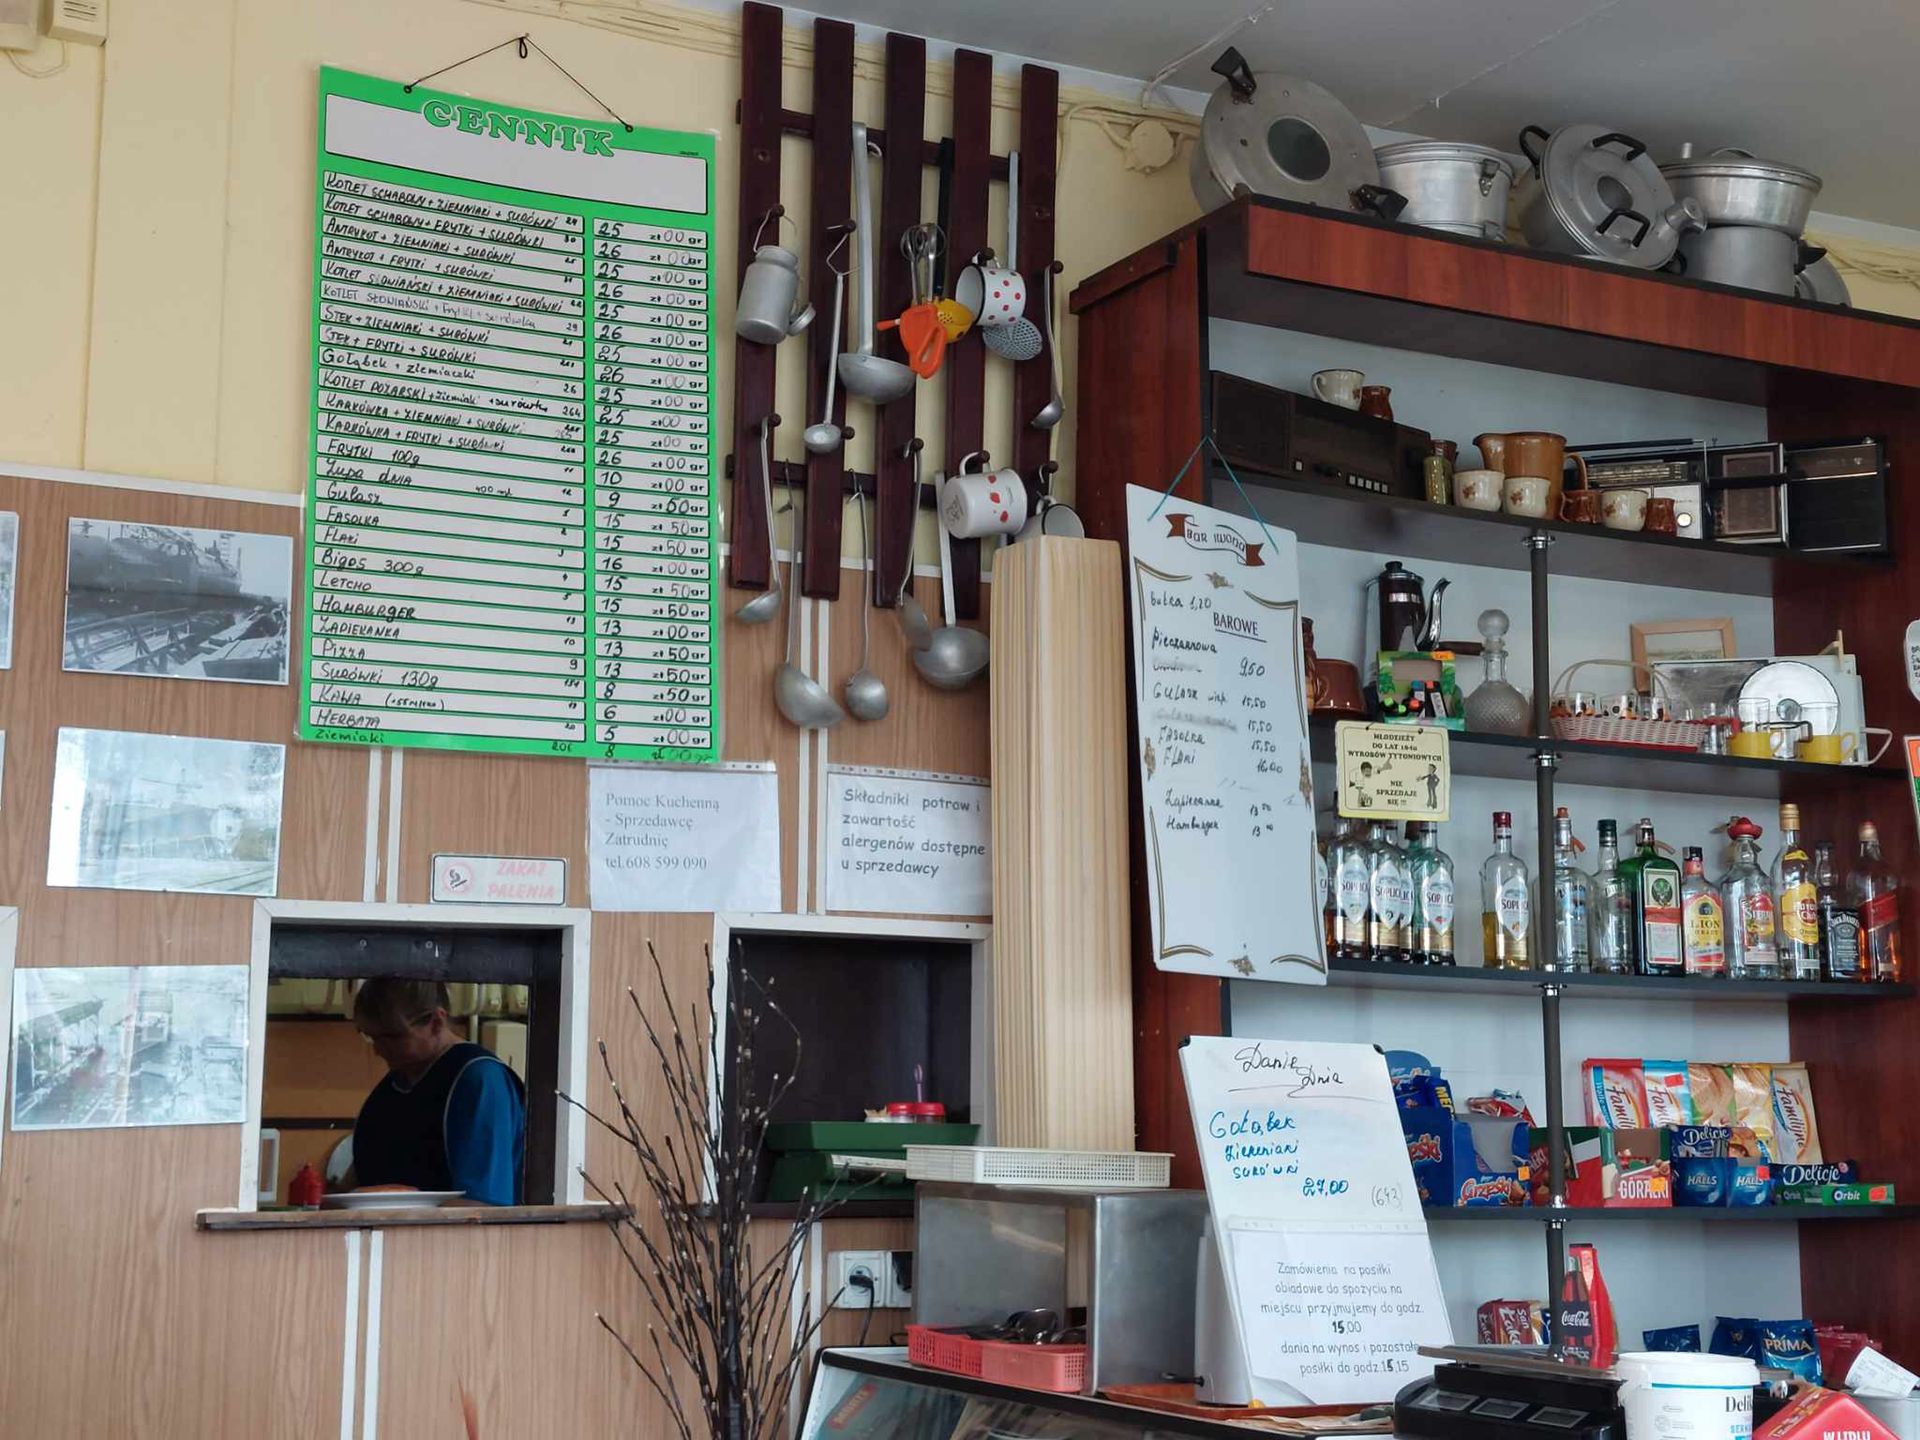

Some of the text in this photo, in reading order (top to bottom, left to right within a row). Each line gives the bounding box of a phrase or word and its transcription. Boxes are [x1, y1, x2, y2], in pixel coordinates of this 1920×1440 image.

[423, 100, 615, 157] CENNIK
[326, 173, 366, 193] KOTLET
[507, 210, 557, 229] SURÓWKI
[324, 194, 362, 212] KOTLET
[434, 219, 474, 236] FRYTKI
[488, 227, 544, 248] SURÓWKI
[598, 223, 624, 236] 25
[464, 246, 516, 264] SURÓWKI
[599, 243, 621, 258] 26
[390, 254, 427, 269] FRYTKI
[598, 263, 624, 279] 25
[324, 283, 359, 301] KOTLET
[325, 260, 362, 279] KOTLET
[515, 294, 563, 313] SURÓWKI
[598, 283, 623, 298] 26
[599, 305, 624, 318] 25
[324, 304, 353, 323] STEK
[438, 327, 490, 344] SURÓWKI
[601, 325, 623, 340] 26
[366, 337, 405, 354] FRYTKI
[421, 345, 477, 362] SURÓWKI
[323, 371, 366, 390] KOTLET
[598, 387, 625, 404] 25
[405, 430, 441, 445] FRYTKI
[600, 430, 623, 444] 25
[328, 439, 373, 459] FRYTKI
[599, 451, 621, 465] 26
[326, 460, 364, 480] Zupa
[601, 472, 622, 485] 10
[609, 492, 620, 507] 9
[327, 505, 379, 526] FASOLKA
[603, 514, 625, 528] 15
[603, 535, 624, 550] 15
[321, 548, 367, 571] Bigos
[602, 558, 623, 570] 16
[604, 576, 627, 591] 15
[602, 598, 622, 612] 15
[602, 620, 621, 636] 13
[1213, 612, 1259, 636] BAROWE
[604, 642, 622, 657] 13
[604, 663, 621, 679] 13
[1240, 657, 1265, 677] 9,50
[604, 682, 616, 699] 8
[604, 705, 617, 720] 6
[604, 725, 618, 740] 5
[1248, 720, 1272, 733] 15,50
[1374, 733, 1415, 741] MŁODZIEŻY
[1252, 739, 1276, 753] 15,50
[1389, 752, 1441, 761] TYTONIOWYCH
[844, 789, 909, 806] Składniki
[922, 797, 970, 811] potraw
[1376, 789, 1417, 797] SPRZEDAJE
[606, 793, 720, 812] Pomoc Kuchenną
[615, 813, 693, 831] Sprzedawcę
[842, 813, 916, 829] zawartość
[605, 832, 669, 848] Zatrudnię
[842, 834, 986, 858] alergenów dostępne
[496, 861, 548, 876] ZAKAZ
[655, 856, 679, 869] 599
[683, 857, 707, 870] 090
[841, 859, 940, 878] u sprzedawcy
[488, 884, 555, 898] PALENIA
[1690, 918, 1720, 930] LION
[1234, 1043, 1299, 1072] Danie
[1301, 1065, 1343, 1087] Dnia
[1688, 1175, 1717, 1185] HALLS
[1736, 1175, 1764, 1187] HALLS
[1783, 1164, 1840, 1185] Delicje
[1303, 1177, 1349, 1197] 27,00
[1834, 1191, 1860, 1200] Orbit
[1277, 1262, 1391, 1278] Zamówienia na posiłki
[1275, 1282, 1402, 1294] obiadowe do na
[1261, 1302, 1424, 1317] miejscu przyjmujemy do godz.
[1517, 1309, 1529, 1329] San
[1281, 1341, 1309, 1354] dania
[1313, 1343, 1325, 1354] na
[1328, 1342, 1359, 1356] wynos
[1300, 1361, 1350, 1377] posiłki do
